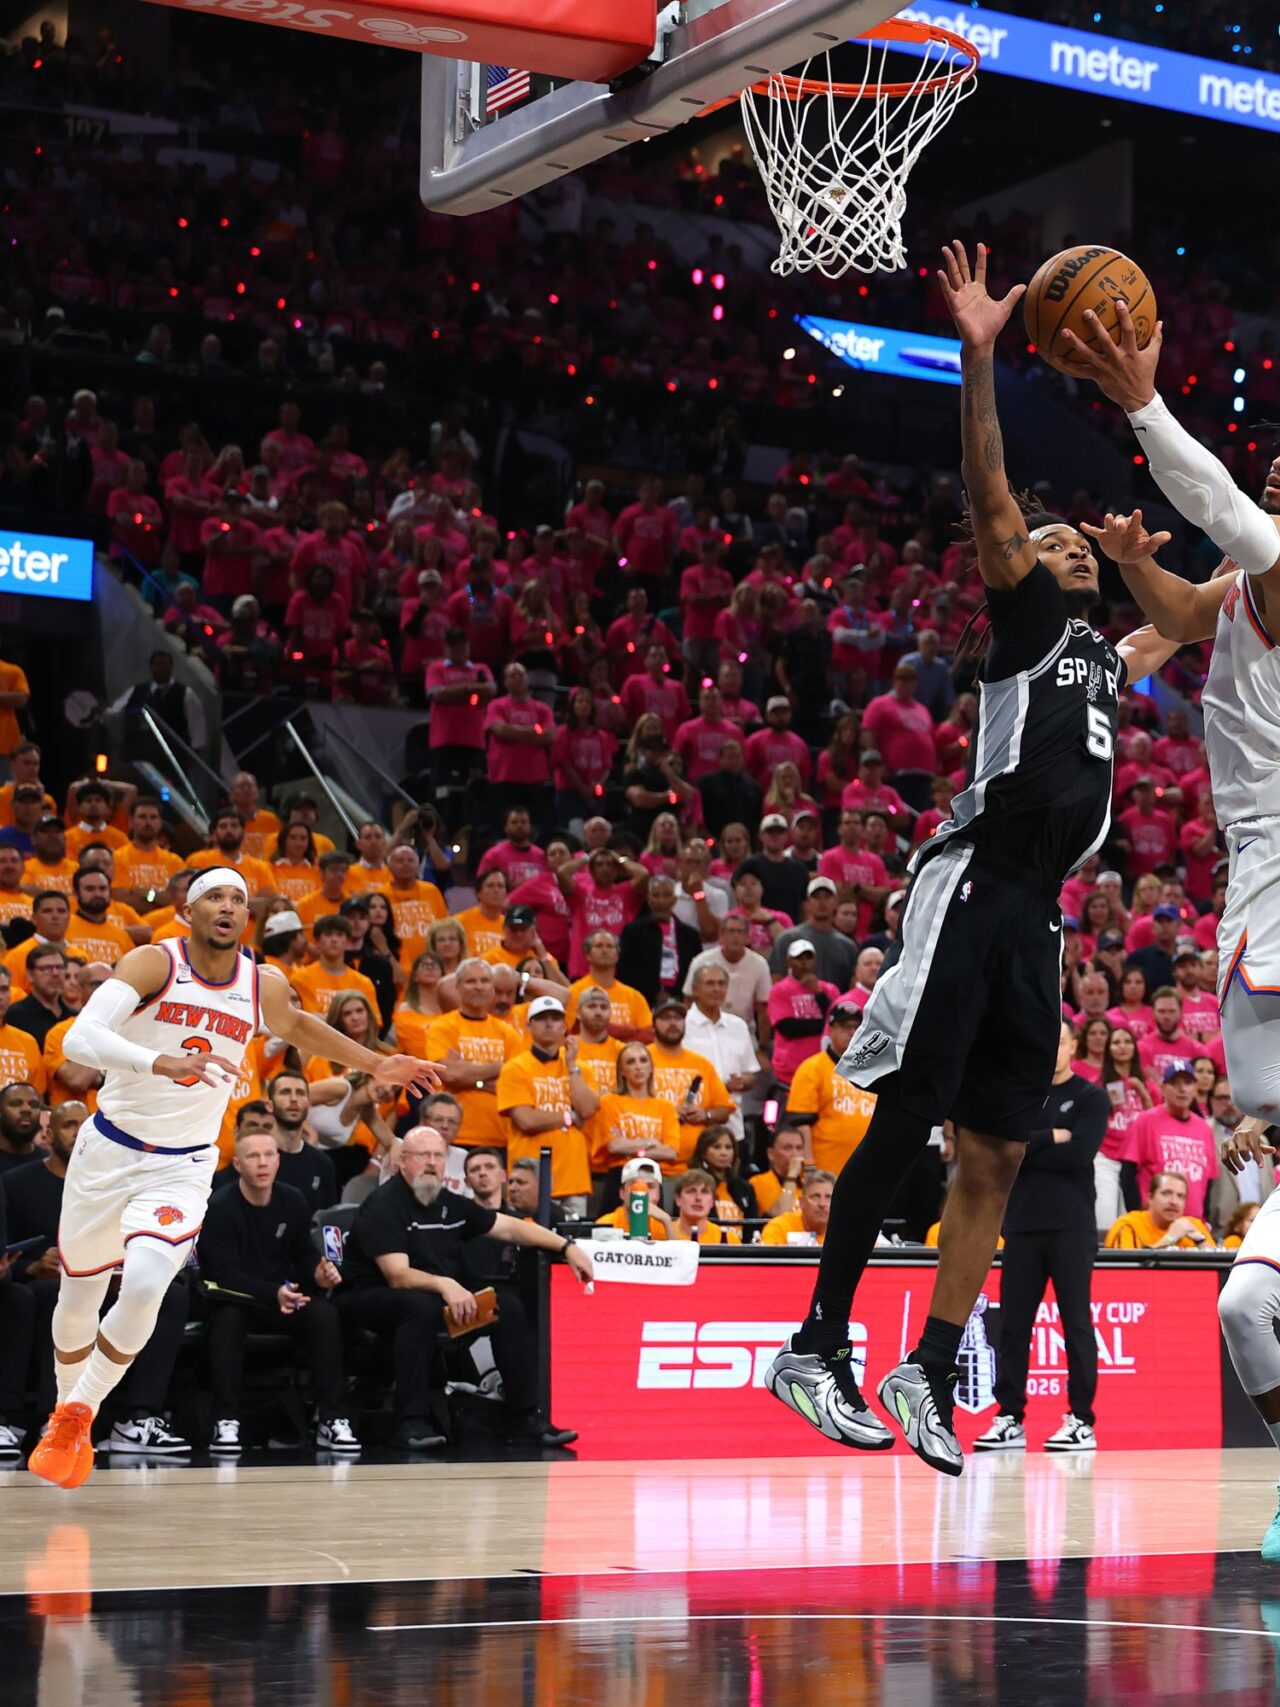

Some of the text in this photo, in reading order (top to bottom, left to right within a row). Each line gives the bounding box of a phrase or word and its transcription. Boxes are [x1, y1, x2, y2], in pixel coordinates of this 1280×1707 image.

[184, 0, 354, 28] Sta
[1050, 40, 1159, 92] meter
[0, 540, 68, 583] ter
[1086, 702, 1114, 761] 5
[155, 1001, 253, 1043] NEW YORK
[173, 1036, 212, 1087] 3
[632, 1200, 644, 1214] G
[594, 1252, 673, 1268] GATORADE
[1106, 1303, 1145, 1323] CUP
[1029, 1327, 1136, 1366] INAL
[1026, 1378, 1060, 1395] 026
